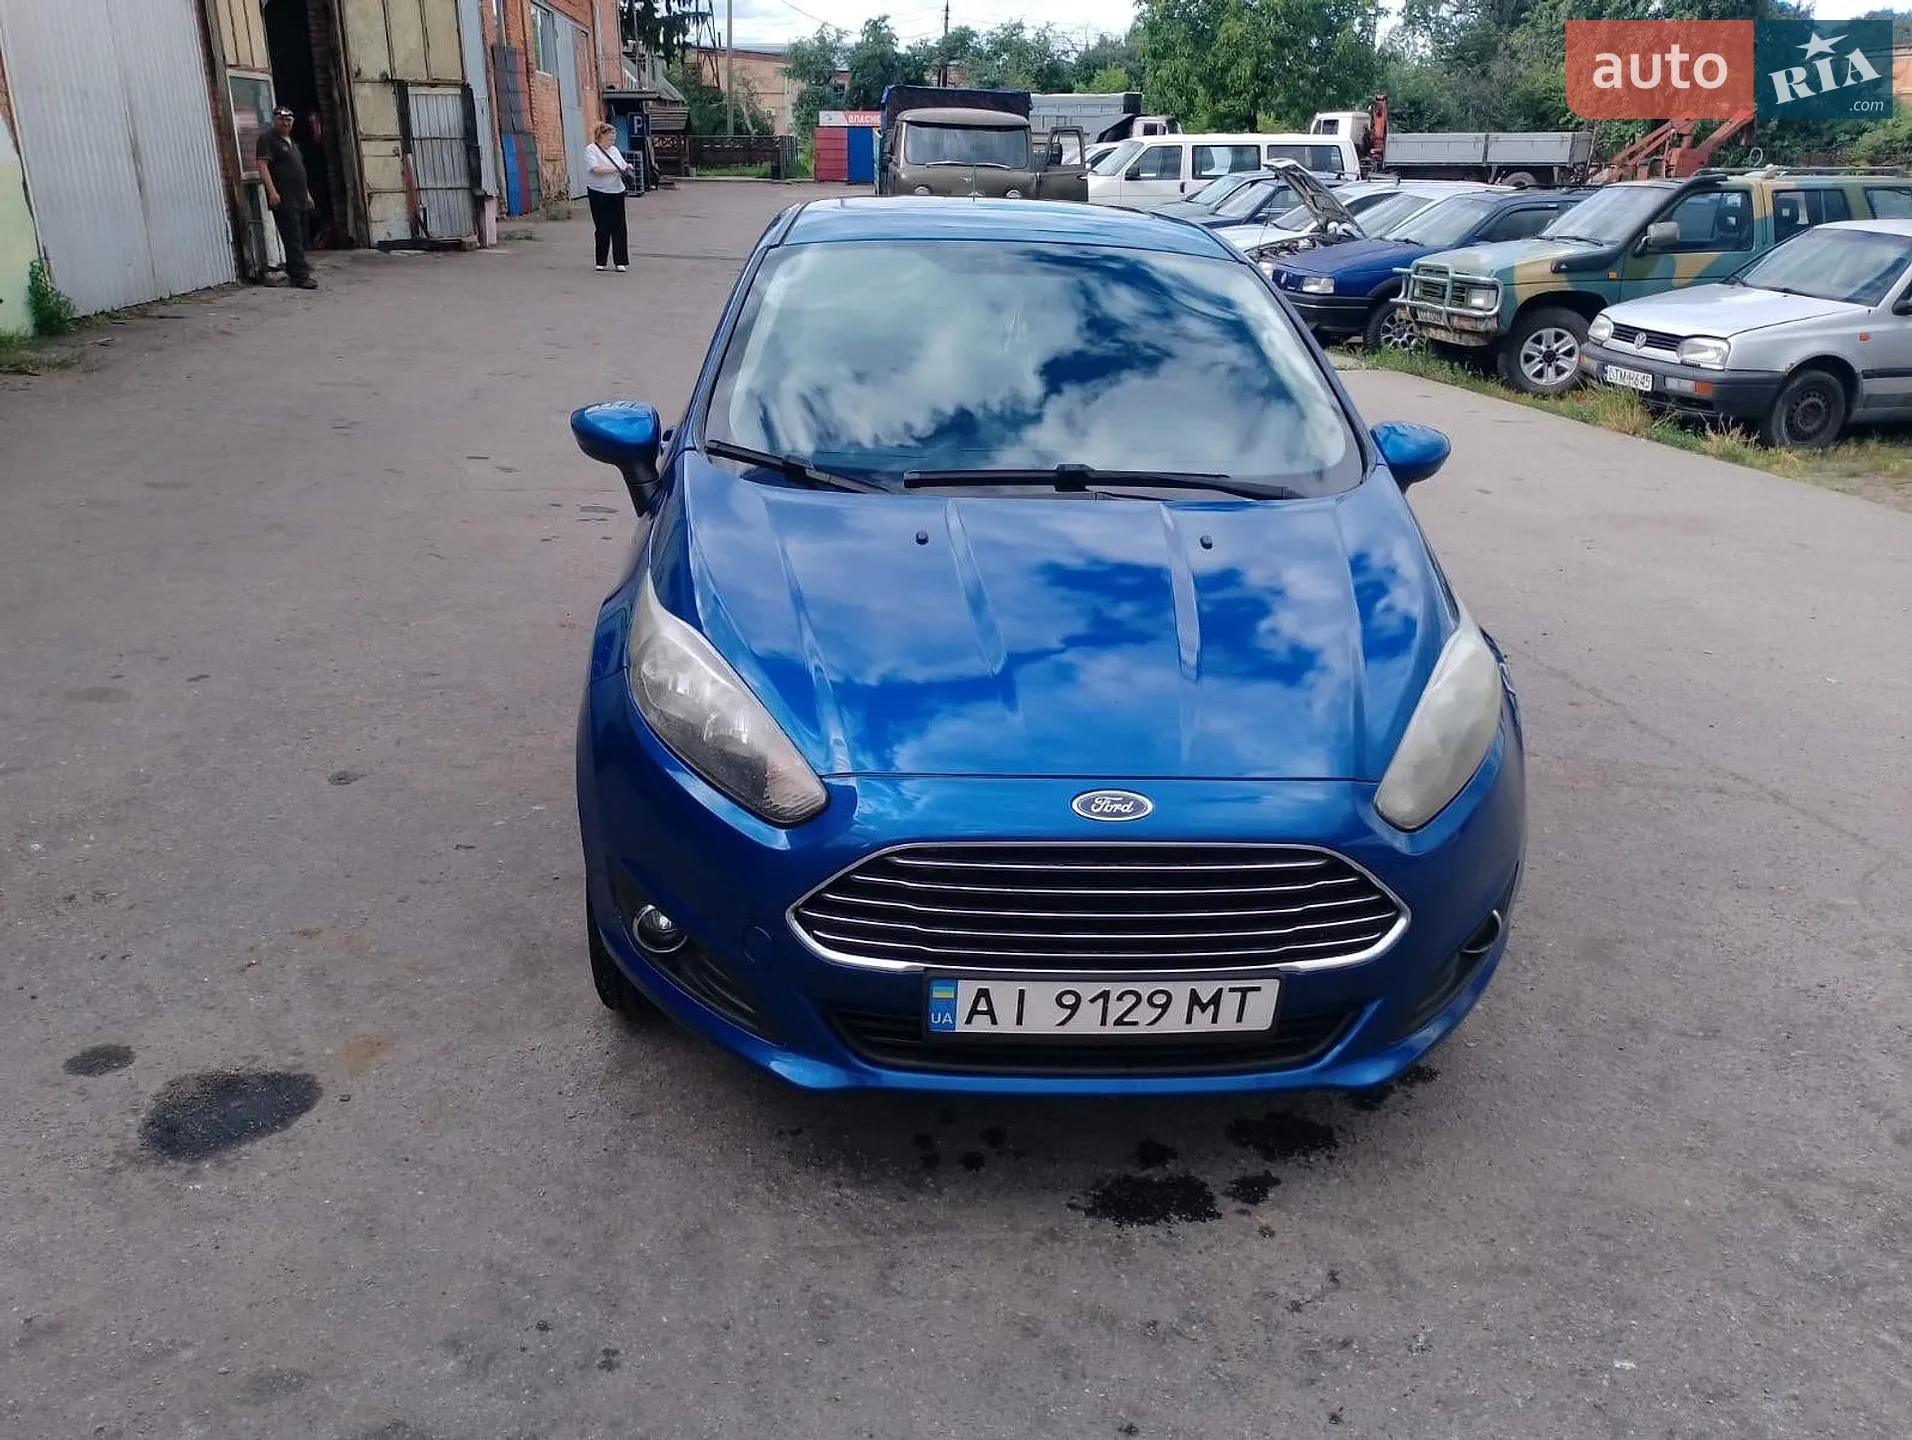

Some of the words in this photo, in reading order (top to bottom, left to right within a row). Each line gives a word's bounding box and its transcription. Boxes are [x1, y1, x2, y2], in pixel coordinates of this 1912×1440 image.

[634, 115, 643, 134] P
[1091, 797, 1134, 813] Ford
[1055, 988, 1173, 1026] 9129
[1185, 986, 1262, 1025] MT
[931, 1012, 953, 1024] UA
